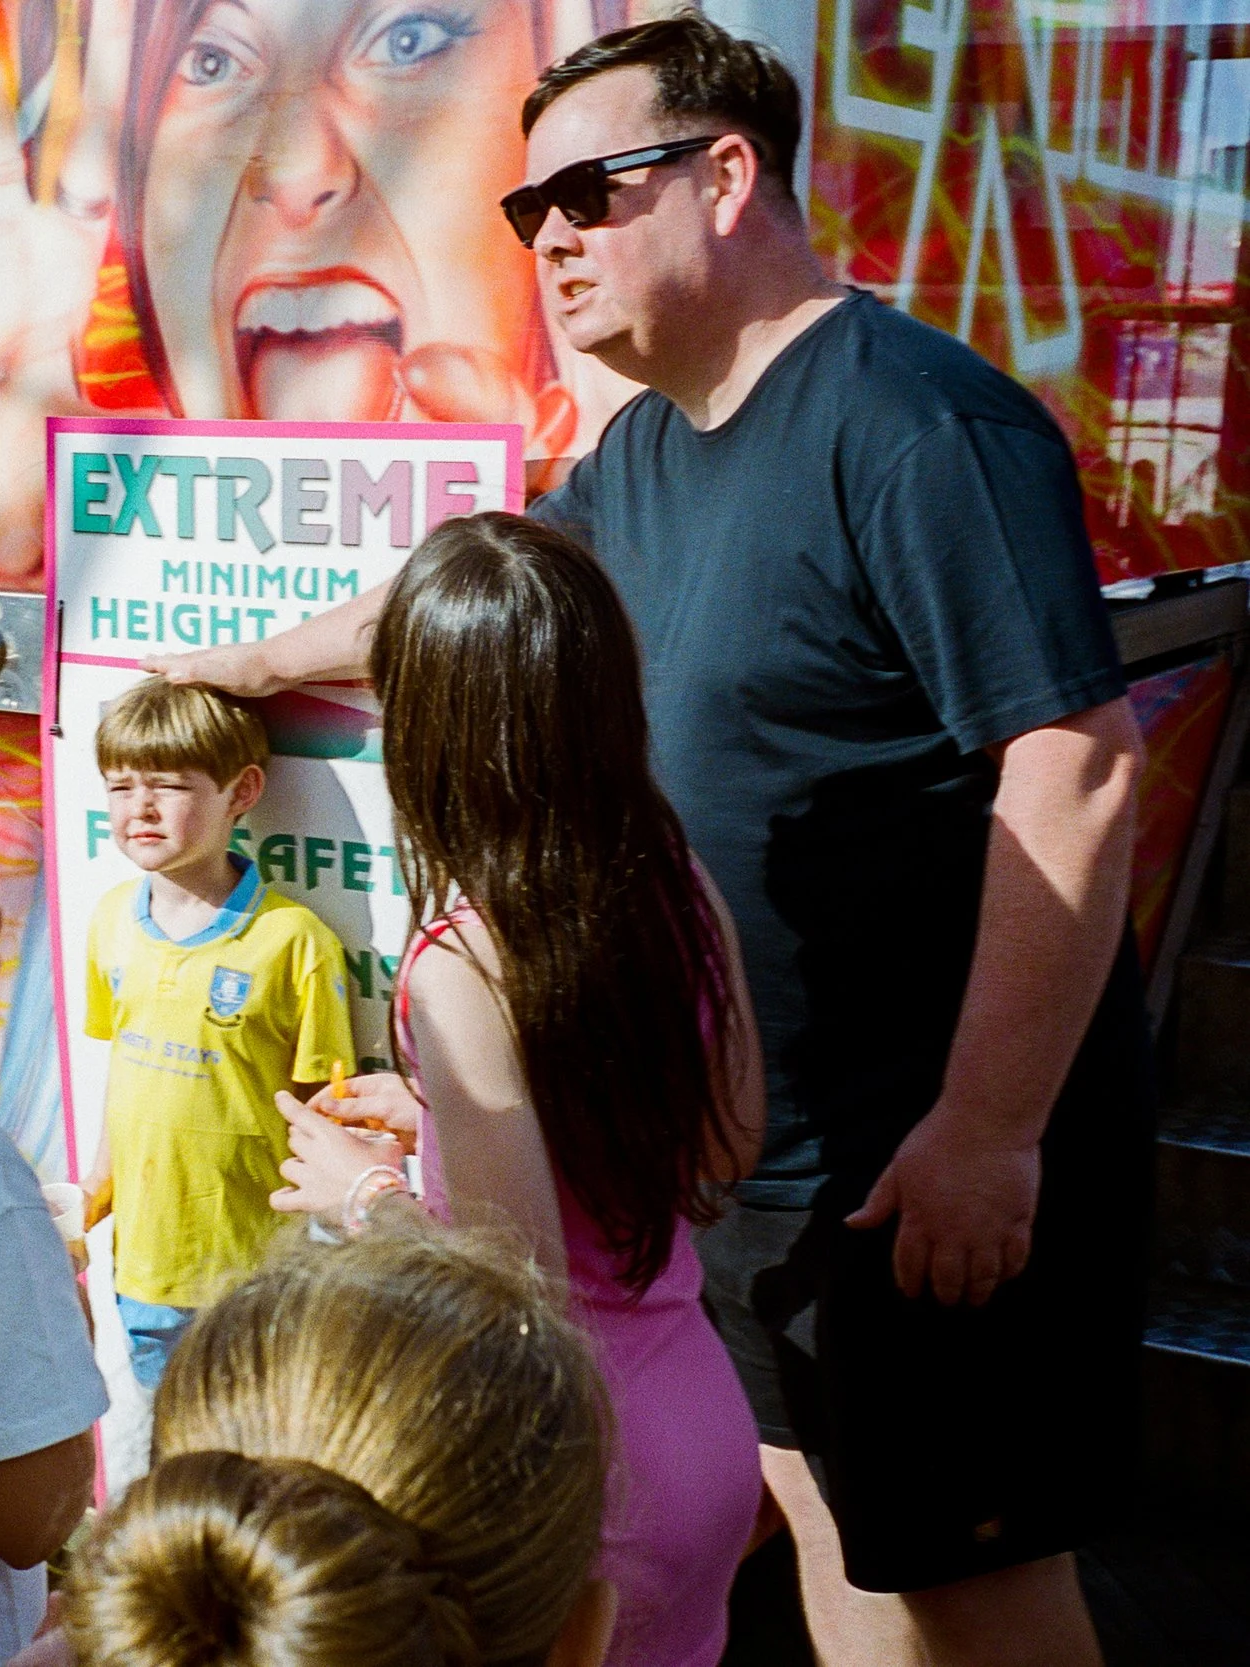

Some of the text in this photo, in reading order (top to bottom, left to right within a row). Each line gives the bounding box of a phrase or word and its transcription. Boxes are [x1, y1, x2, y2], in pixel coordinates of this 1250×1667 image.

[73, 452, 478, 554] EXTREME
[162, 560, 358, 601] MINIMUM
[91, 597, 276, 646] HEIGHT
[228, 828, 407, 896] AFET
